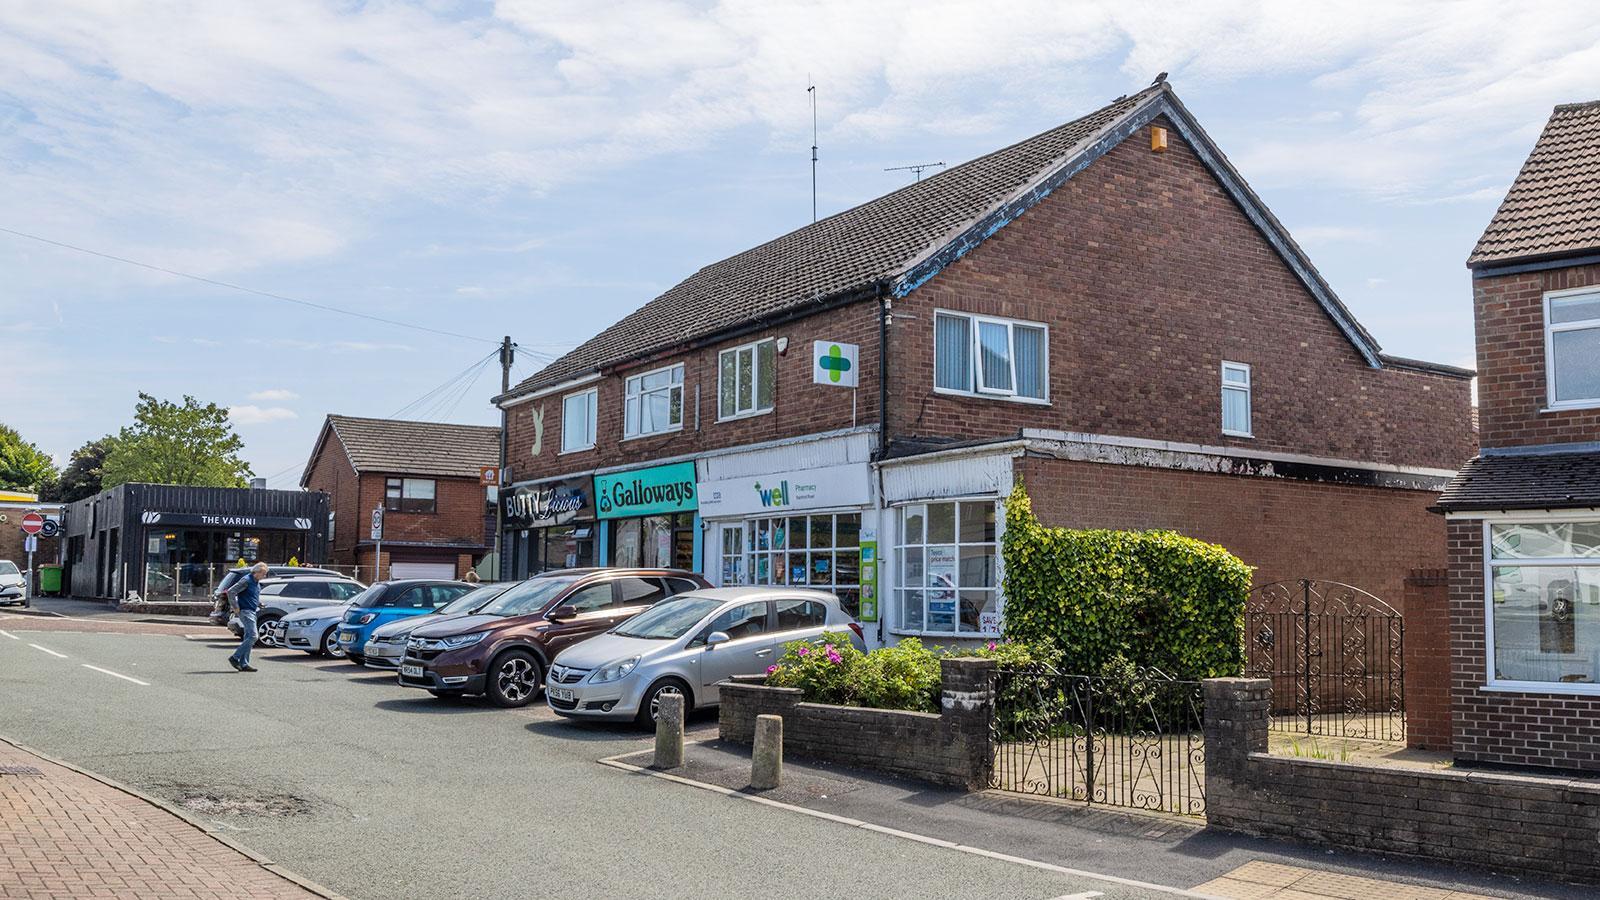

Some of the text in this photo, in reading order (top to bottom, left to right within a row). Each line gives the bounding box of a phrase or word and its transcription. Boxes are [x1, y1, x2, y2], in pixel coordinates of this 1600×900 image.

[613, 479, 694, 507] Galloways
[760, 480, 790, 507] well
[795, 484, 816, 492] Pharmacy
[506, 488, 583, 520] BUTTY Licious
[202, 516, 219, 524] THE
